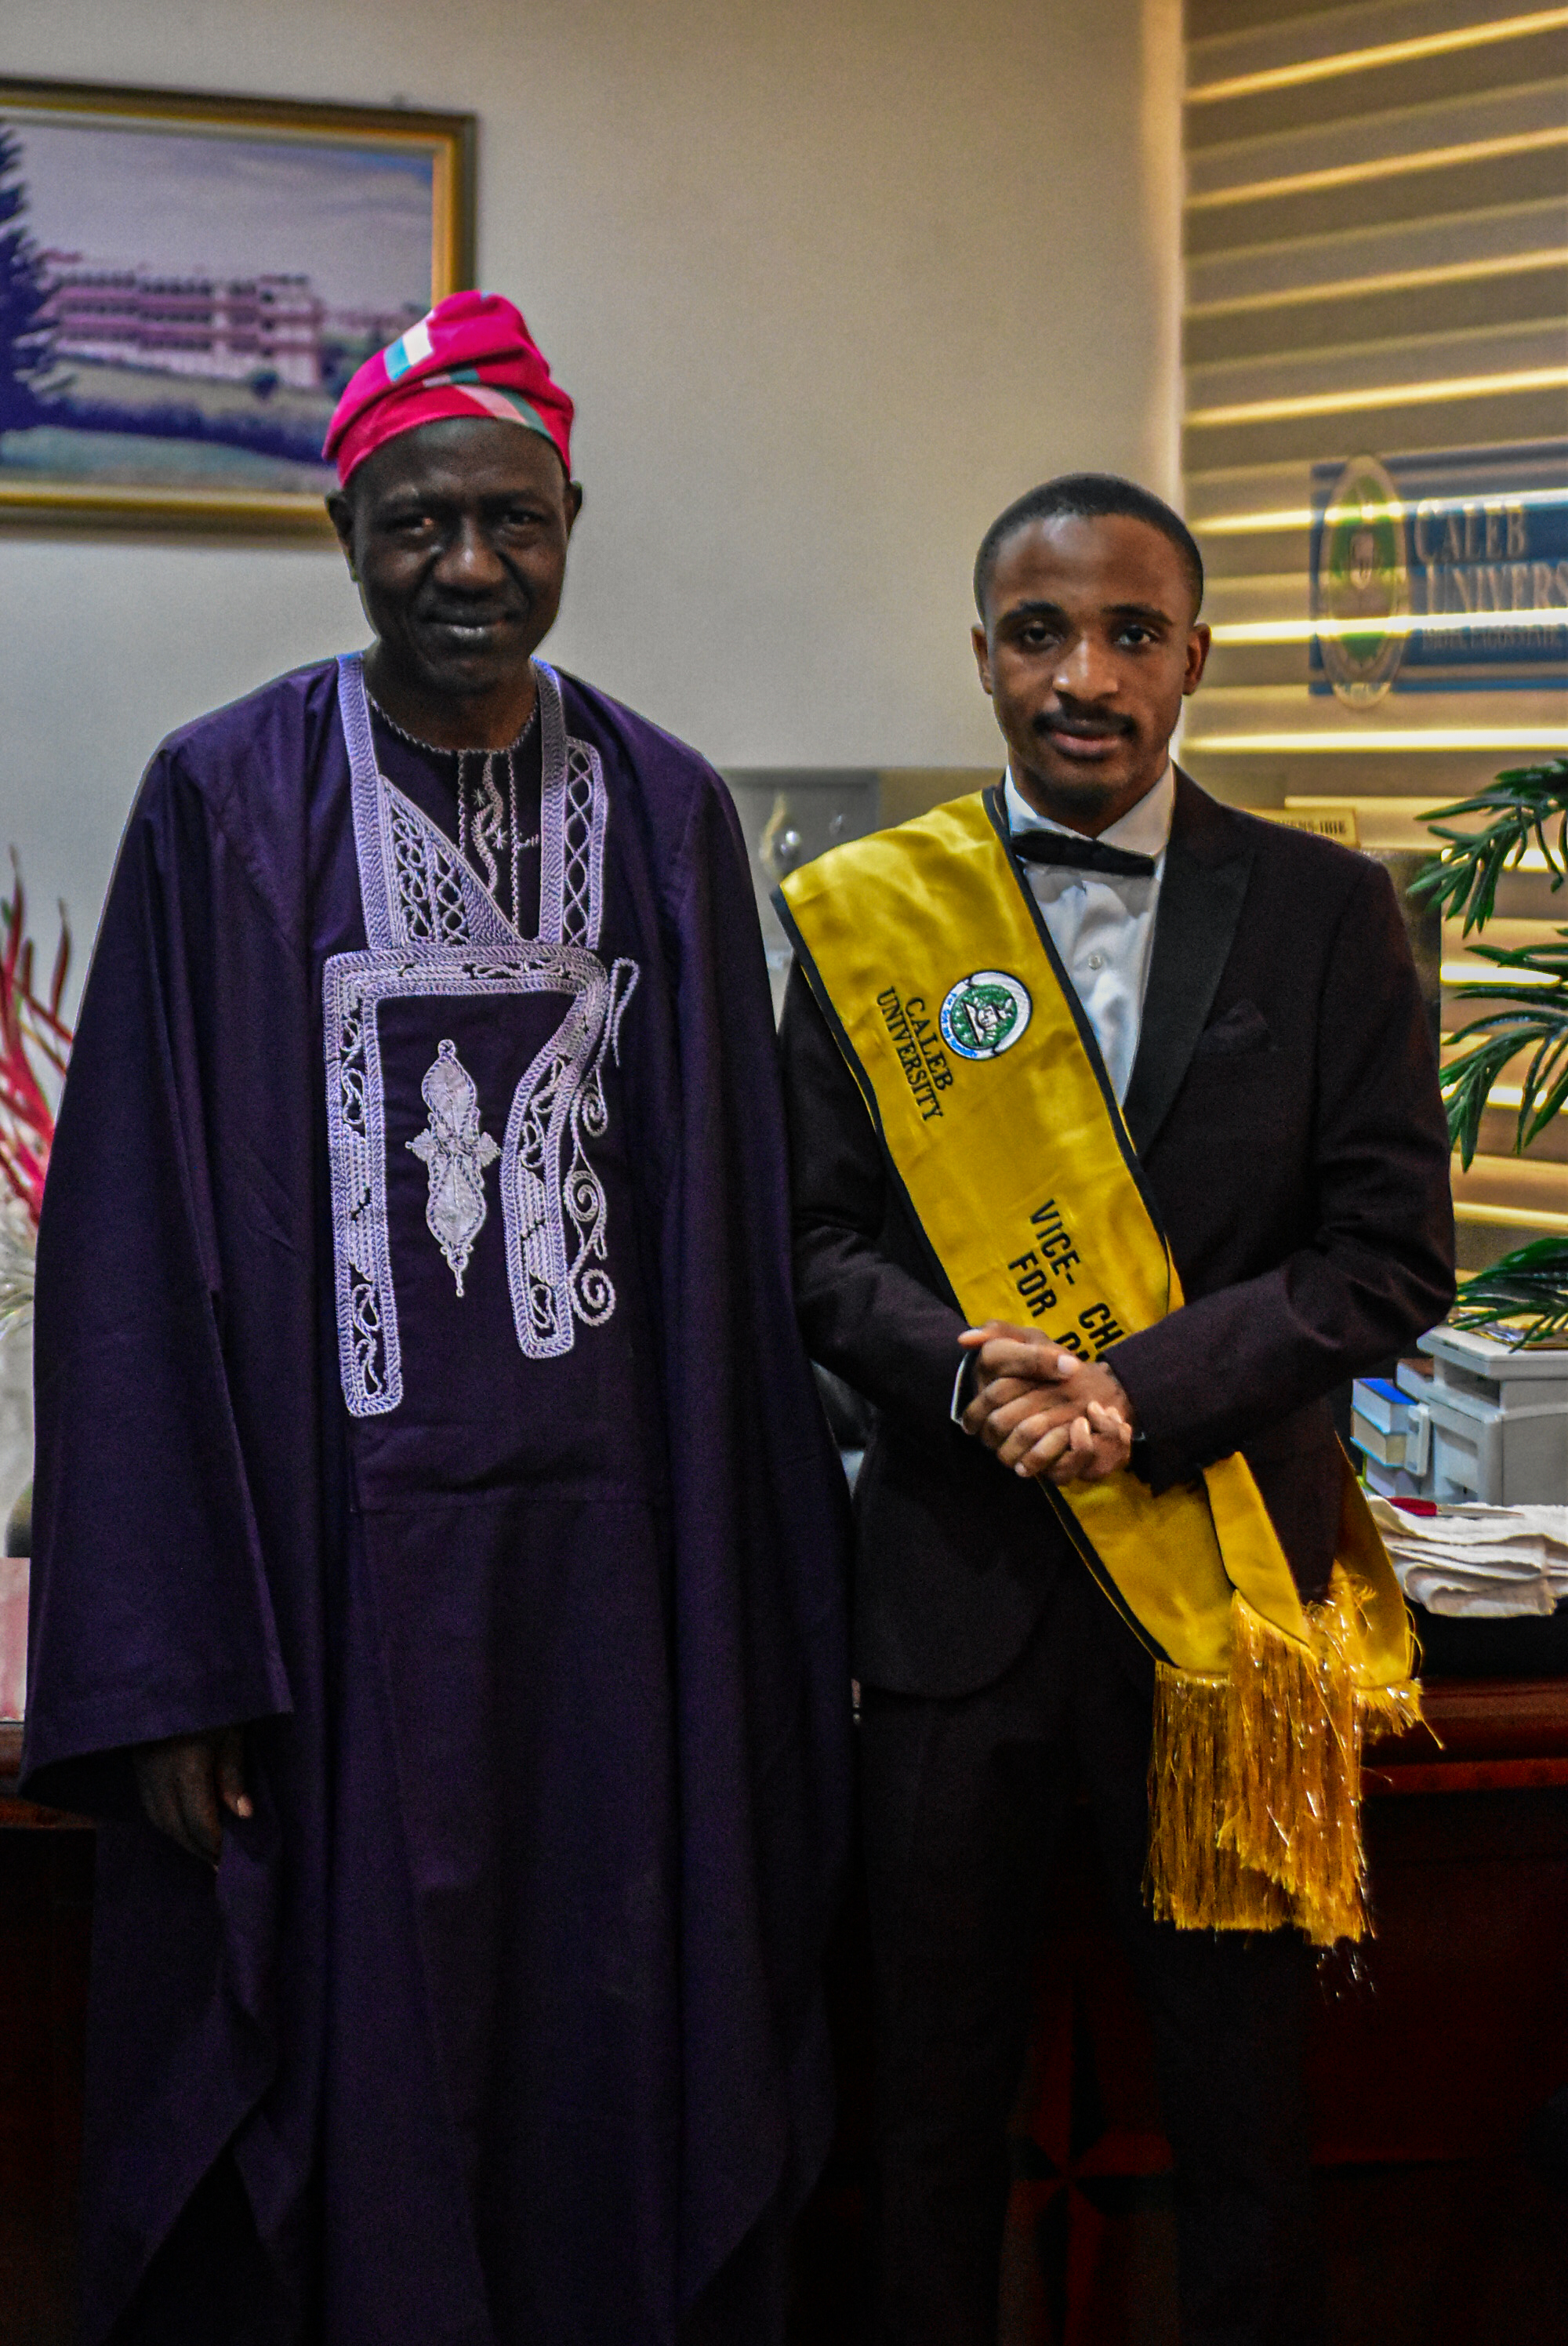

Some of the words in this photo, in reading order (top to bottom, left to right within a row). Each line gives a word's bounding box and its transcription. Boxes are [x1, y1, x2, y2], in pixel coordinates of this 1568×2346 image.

[1415, 498, 1526, 563] CALEB
[877, 986, 944, 1121] UNIVERSITY
[906, 996, 953, 1091] CALEB
[1007, 1252, 1058, 1318] FOR
[1030, 1198, 1081, 1285] VICE-
[1079, 1302, 1124, 1362] CH
